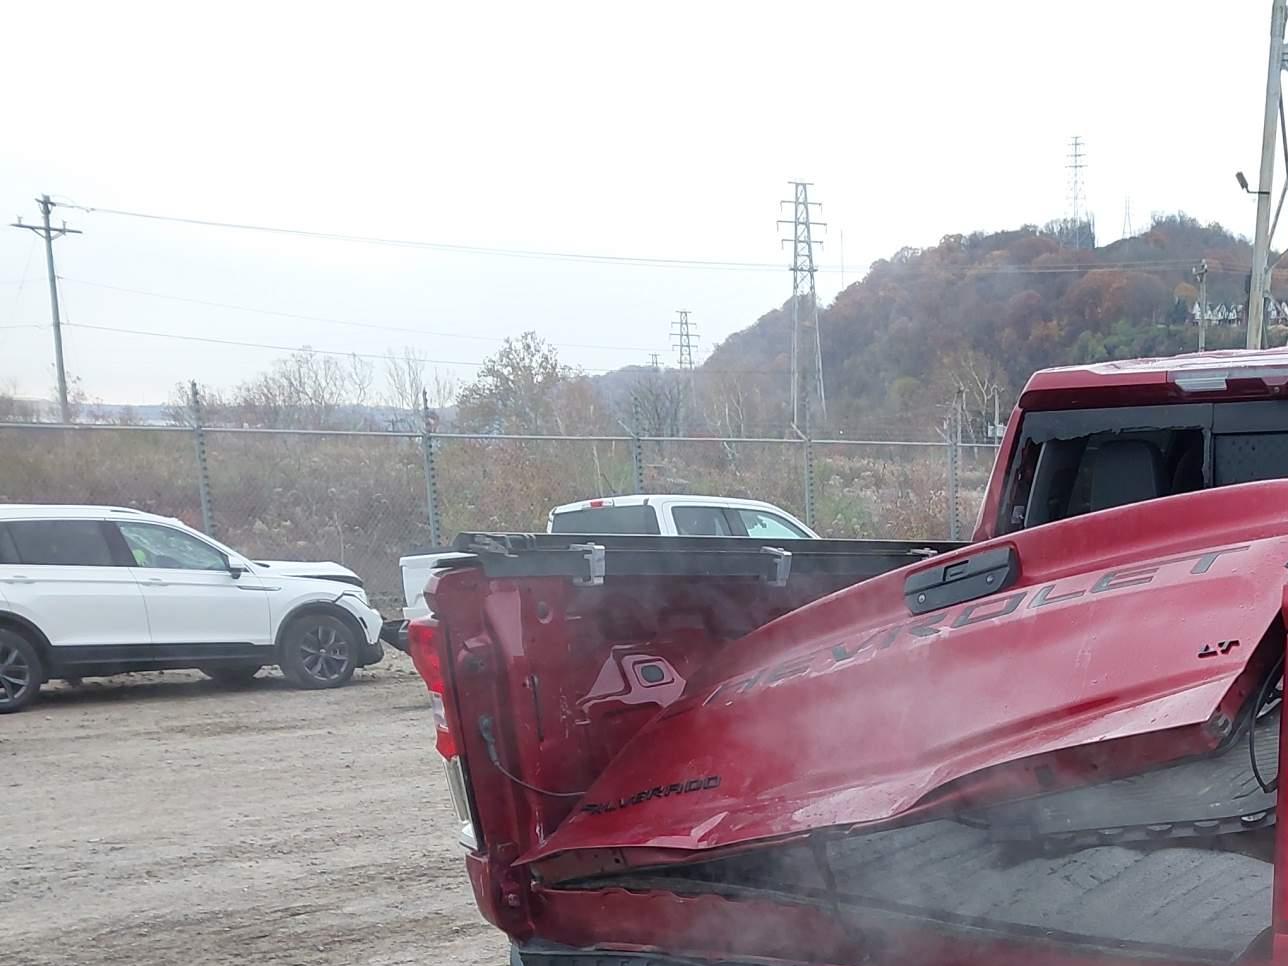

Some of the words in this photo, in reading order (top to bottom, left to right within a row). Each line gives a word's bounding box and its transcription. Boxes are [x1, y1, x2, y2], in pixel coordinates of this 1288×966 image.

[662, 545, 1251, 718] HEVROLET
[1197, 638, 1241, 659] LT
[580, 775, 722, 816] SILVERADO
